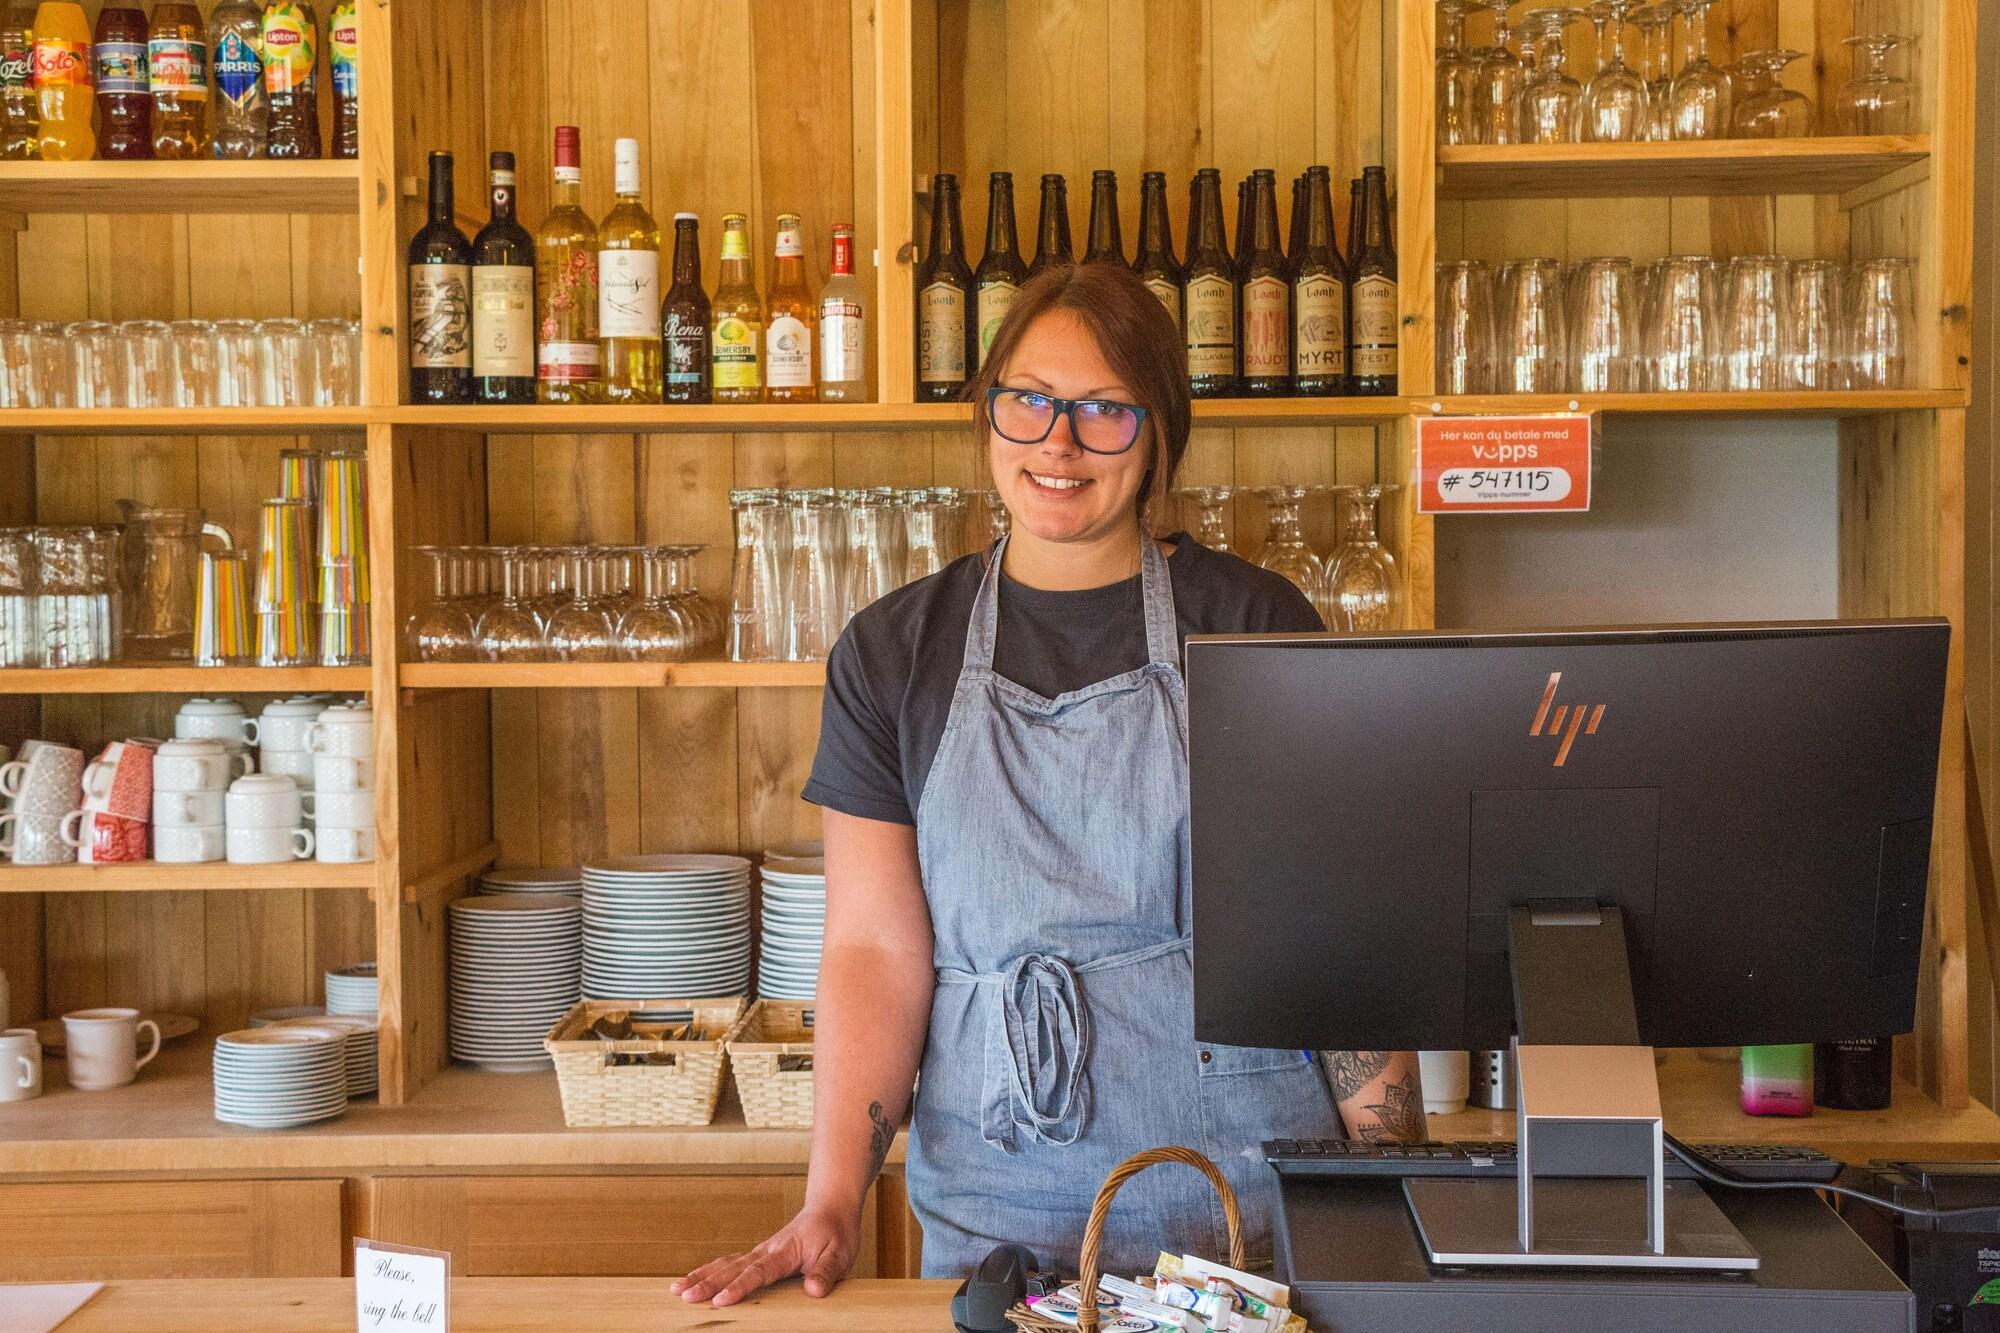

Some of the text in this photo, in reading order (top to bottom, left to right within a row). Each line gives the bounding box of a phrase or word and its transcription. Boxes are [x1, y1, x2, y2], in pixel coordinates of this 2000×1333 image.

[267, 31, 298, 42] Lipton
[336, 31, 355, 42] Lipt
[38, 48, 75, 75] Solo
[214, 61, 260, 73] FARRIS
[1306, 287, 1335, 299] Lomb
[1362, 286, 1390, 299] Lomb
[664, 317, 704, 337] Rena
[715, 344, 752, 354] SOMERSBY
[772, 354, 804, 363] SOMERSBY
[1299, 350, 1344, 365] MYRT
[1361, 353, 1390, 363] FEST
[1440, 428, 1569, 441] Her kan du betale med
[1469, 471, 1553, 491] 547115
[1528, 671, 1607, 768] hp
[373, 1257, 416, 1285] Please,
[363, 1298, 438, 1328] ring the bell
